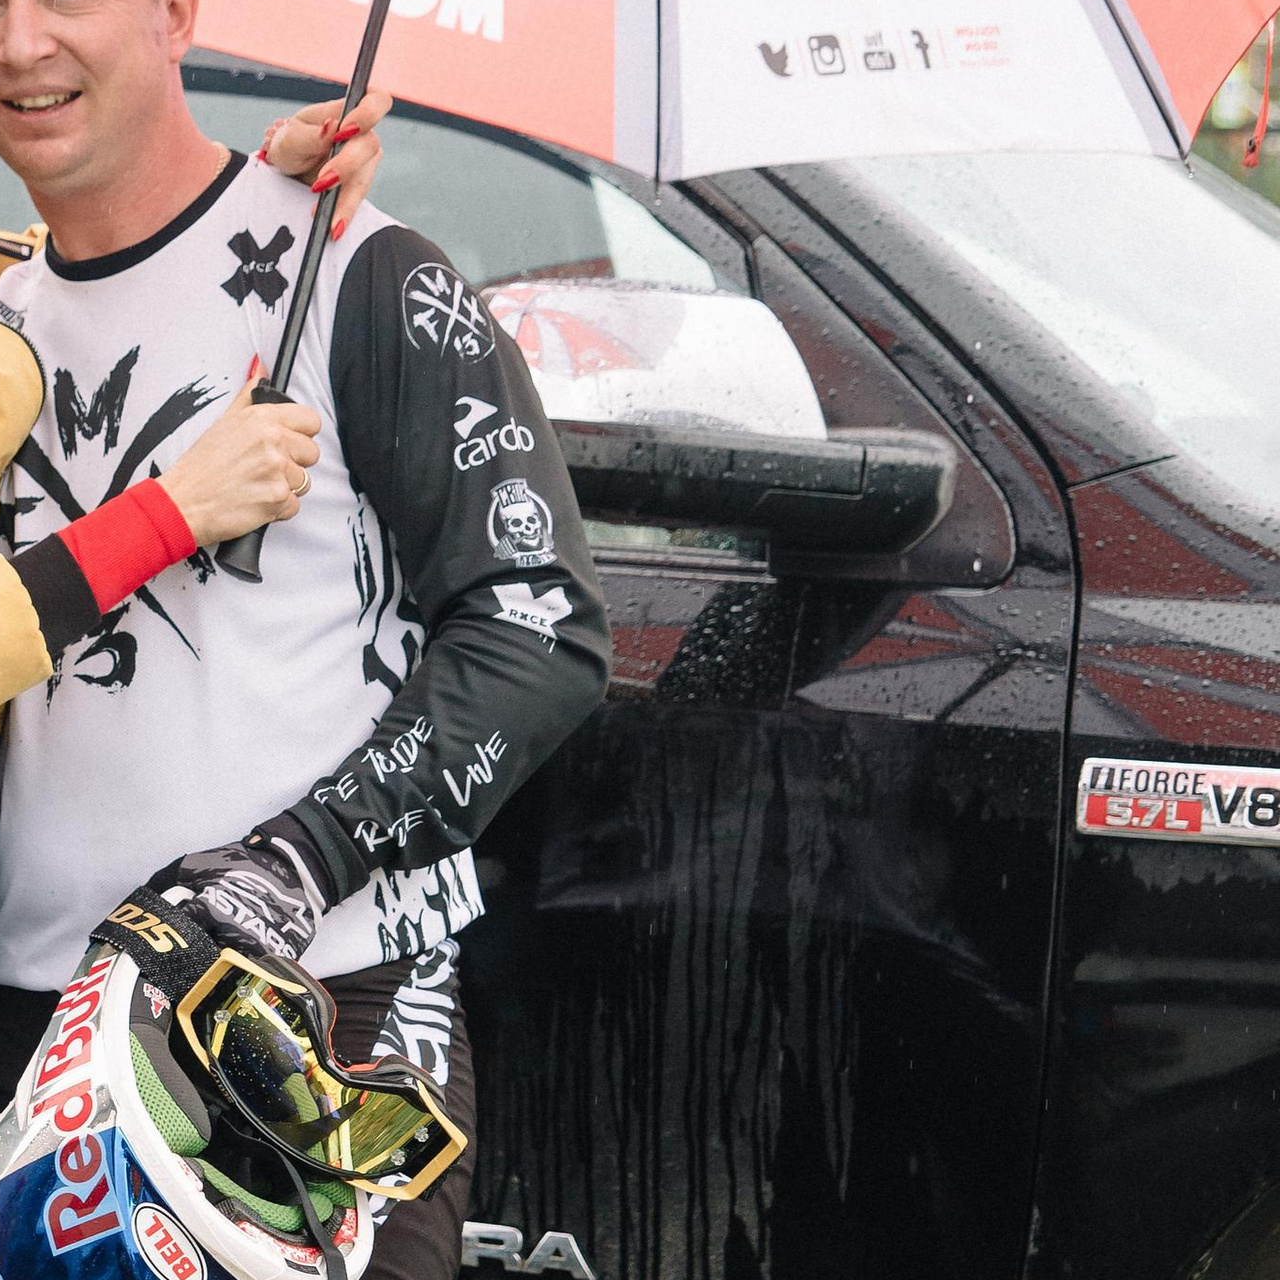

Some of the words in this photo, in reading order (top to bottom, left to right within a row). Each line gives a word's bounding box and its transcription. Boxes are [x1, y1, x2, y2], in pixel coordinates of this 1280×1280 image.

[453, 417, 535, 471] cardo
[442, 729, 508, 807] LIVE
[1105, 797, 1190, 830] 5.7L
[1210, 783, 1280, 829] V8
